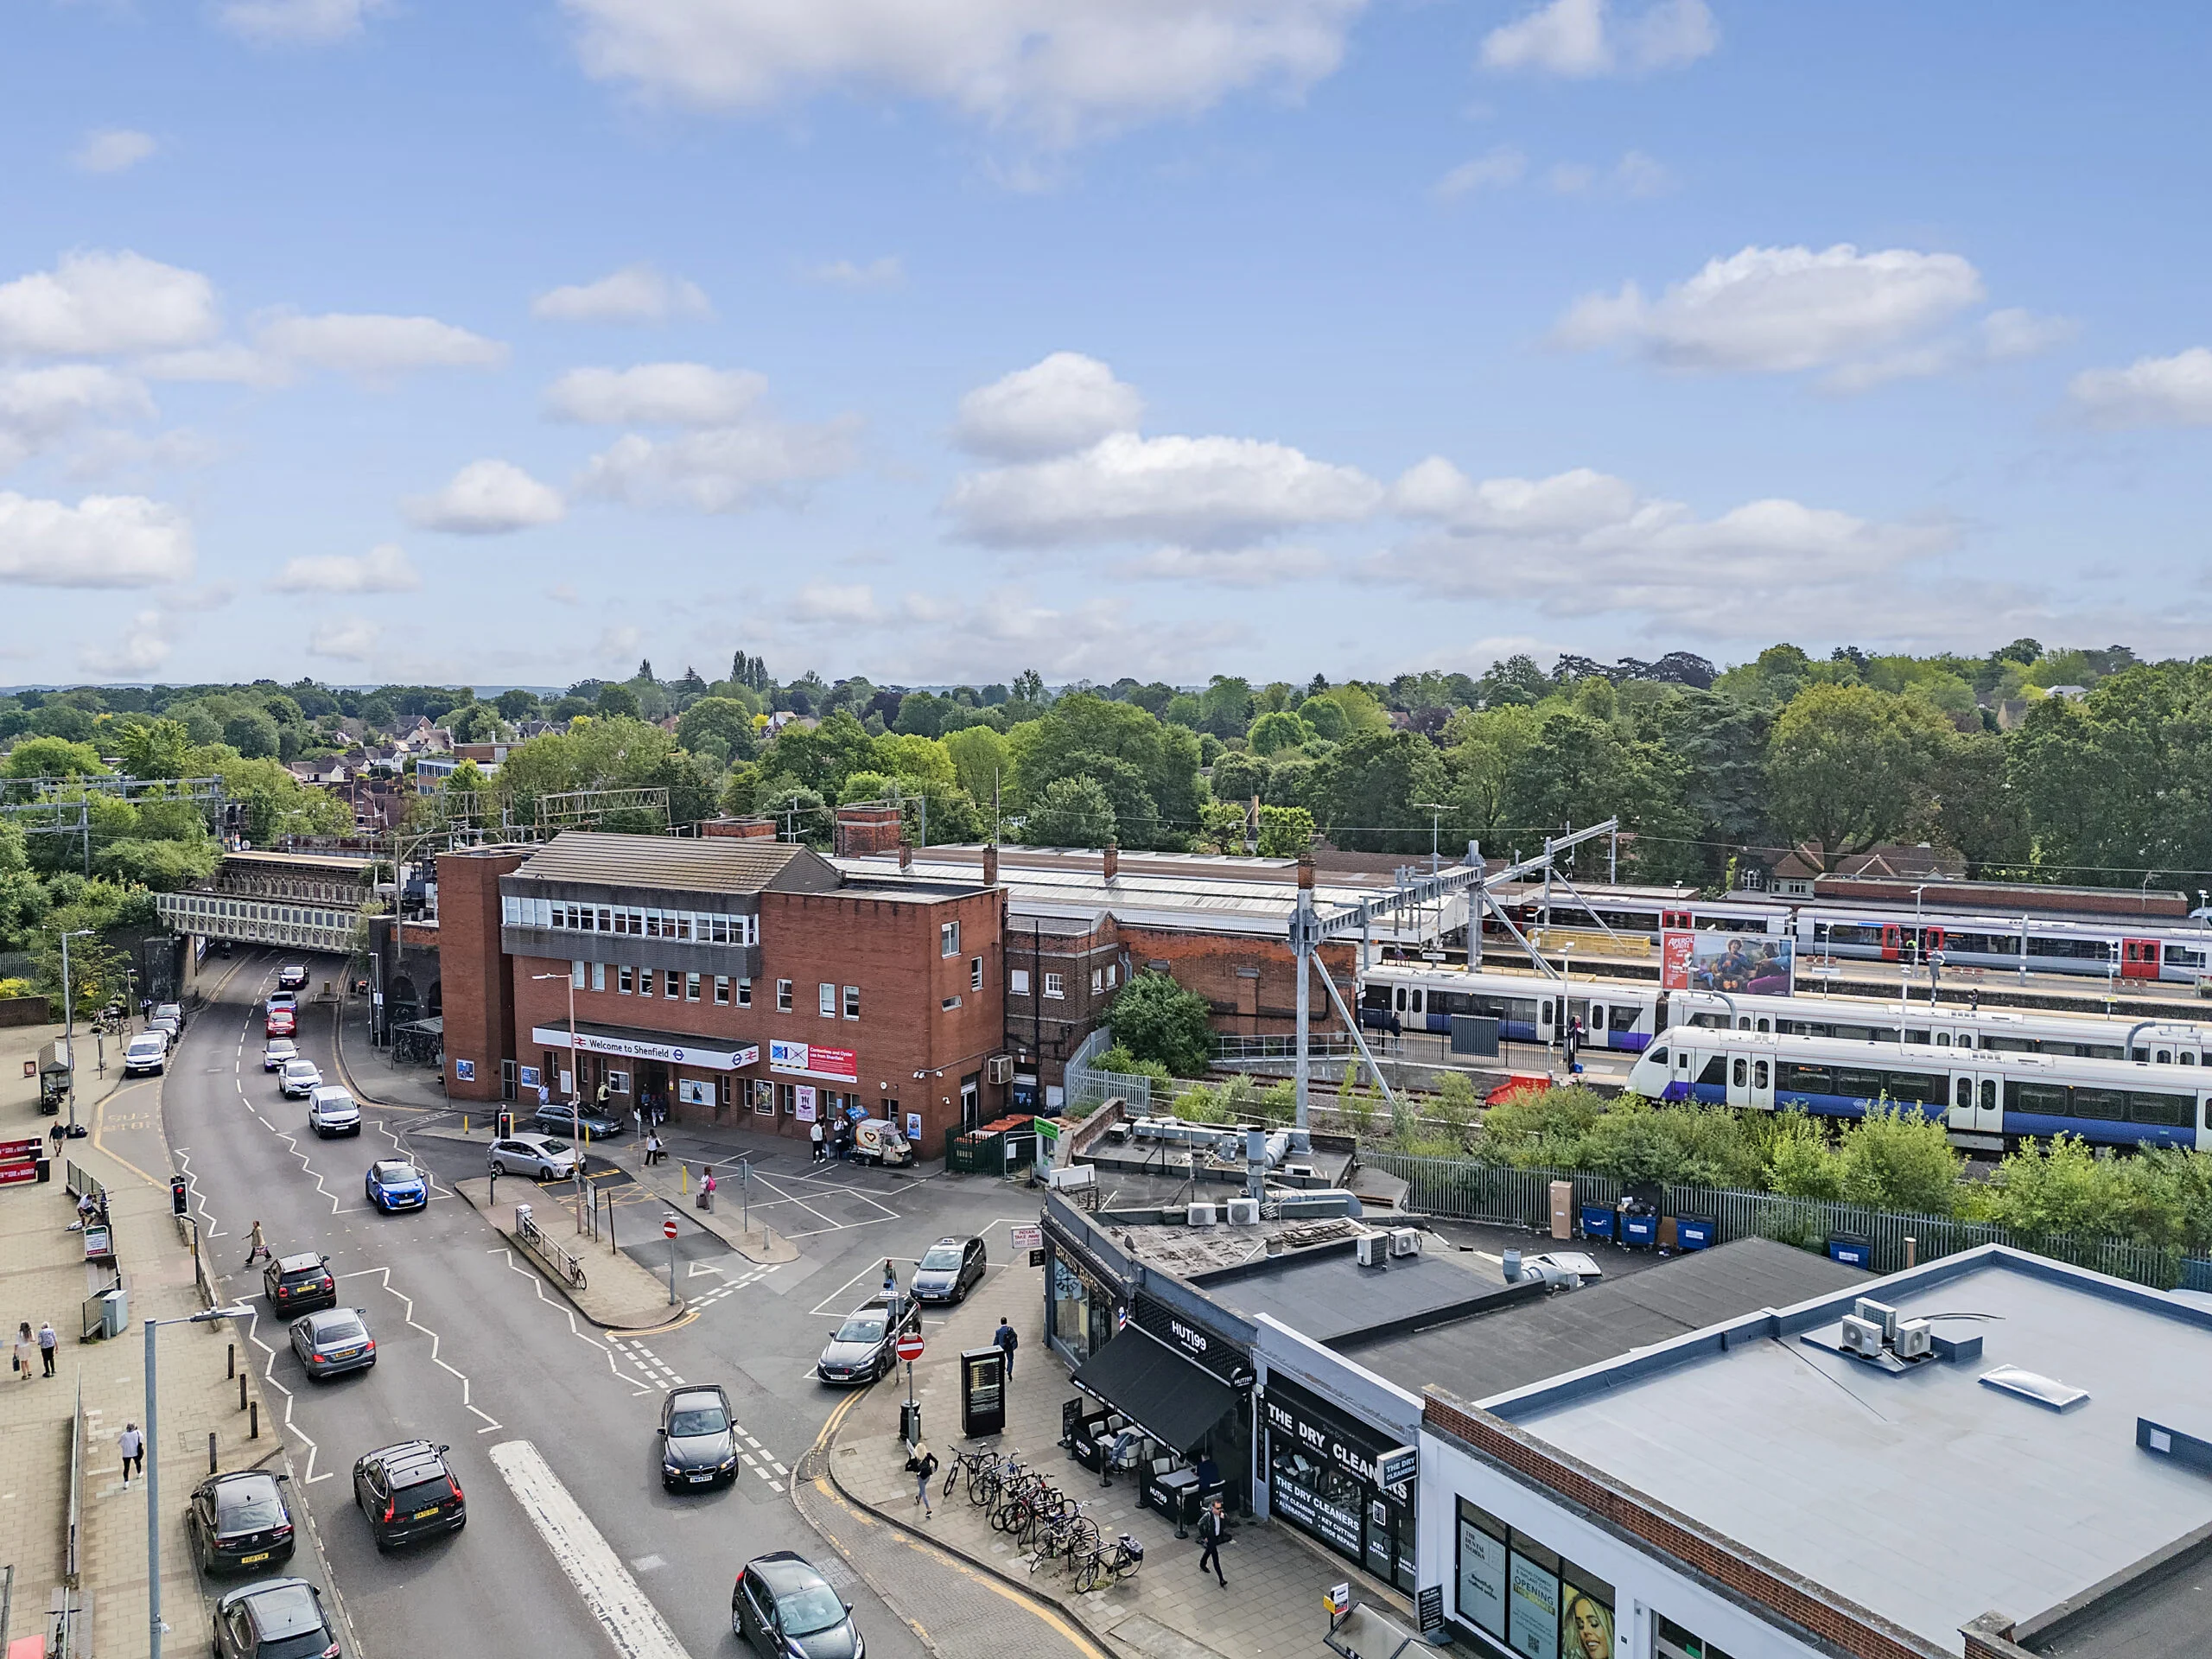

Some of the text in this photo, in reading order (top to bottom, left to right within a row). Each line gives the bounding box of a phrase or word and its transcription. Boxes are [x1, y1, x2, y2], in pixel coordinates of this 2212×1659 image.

[1669, 937, 1694, 947] APEROL
[589, 1039, 669, 1058] Welcome to Shenfield
[1267, 1402, 1293, 1430] THE
[1299, 1421, 1325, 1448] DRY
[1332, 1443, 1408, 1500] CLEANRS
[1385, 1457, 1415, 1473] THE DRY
[1386, 1465, 1416, 1481] CLEANERS
[1275, 1475, 1360, 1531] THE DRY CLEANERS
[1279, 1491, 1316, 1517] DRY CLEANING
[1389, 1495, 1407, 1508] CUTTING
[1279, 1500, 1313, 1524] ALTERATIONS
[1321, 1516, 1357, 1541] KEY CUTTING
[1465, 1529, 1475, 1540] THE
[1321, 1525, 1359, 1553] SHOE REPAIRS
[1372, 1541, 1384, 1552] KEY
[1465, 1536, 1484, 1553] DENTAL
[1369, 1545, 1389, 1560] CUTTING
[1465, 1543, 1485, 1560] WORKS
[1515, 1575, 1554, 1606] OPENING
